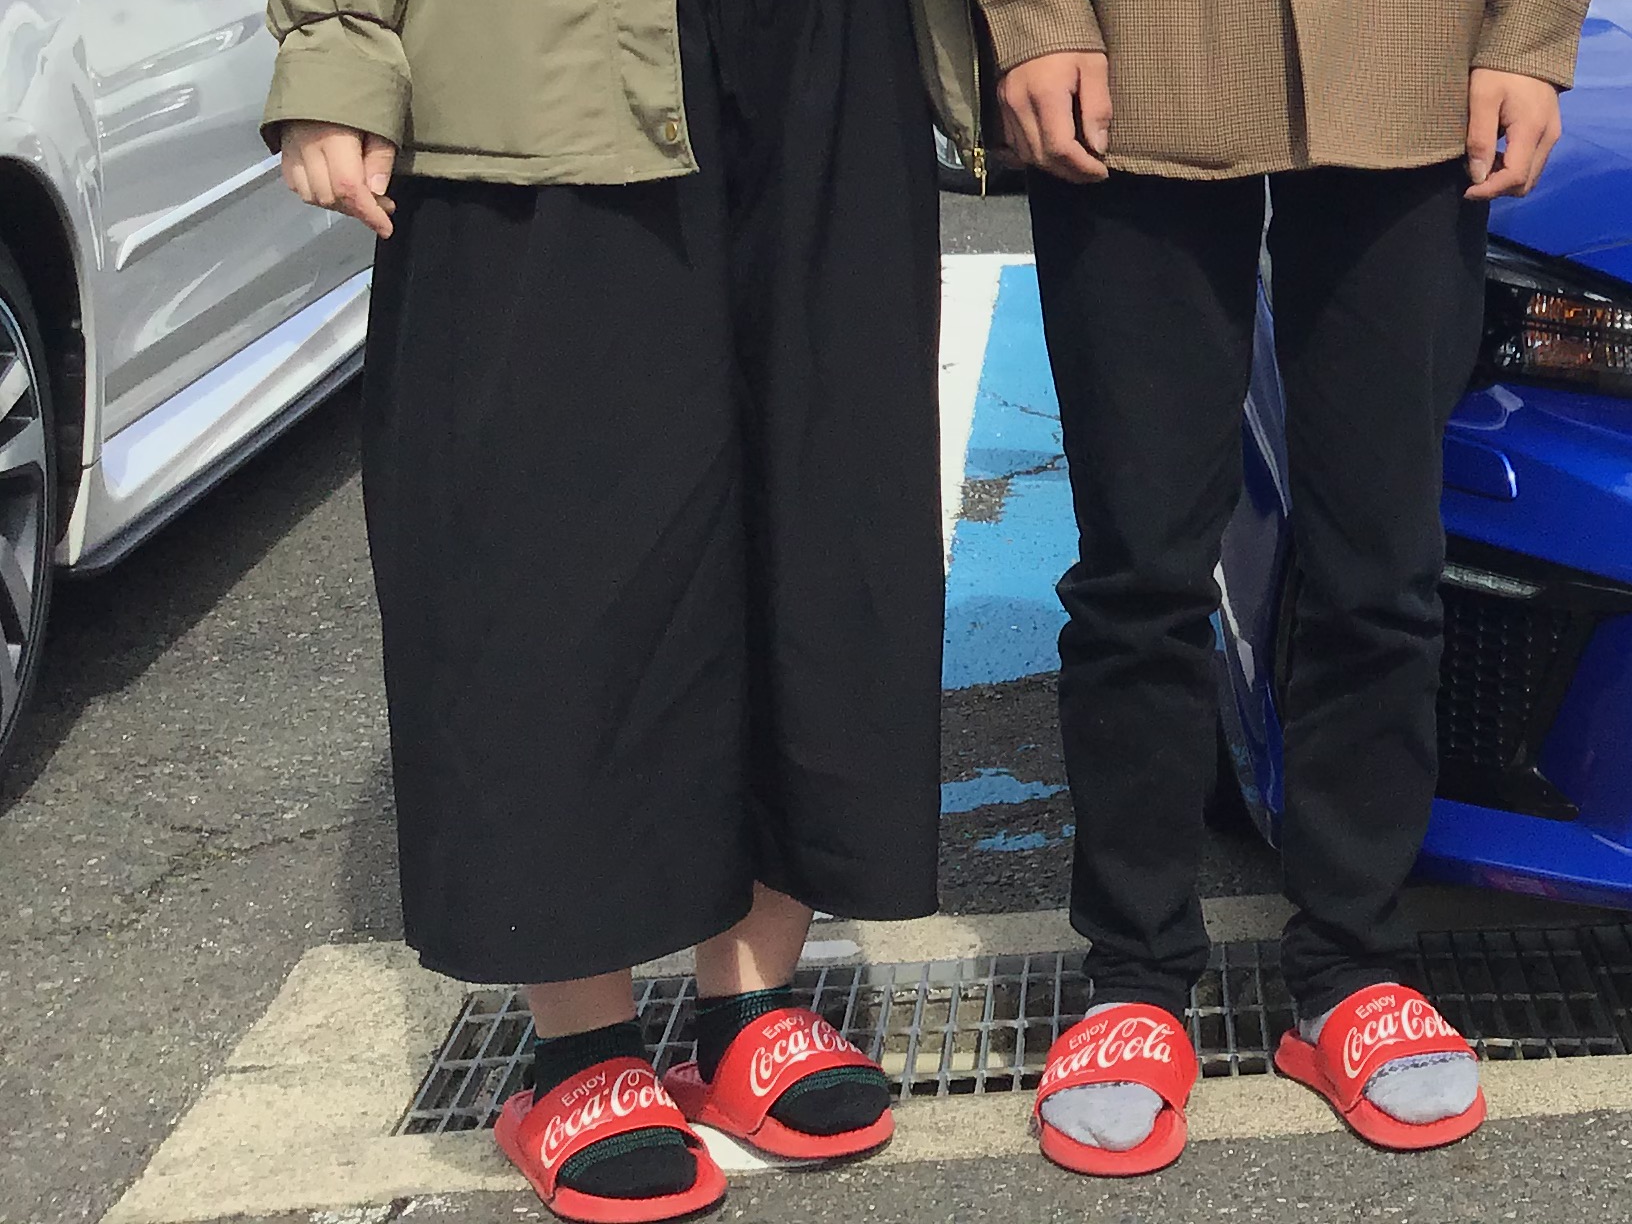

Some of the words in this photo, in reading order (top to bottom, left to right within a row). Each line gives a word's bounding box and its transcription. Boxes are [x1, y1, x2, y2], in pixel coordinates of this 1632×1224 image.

[1355, 994, 1396, 1019] Enjoy
[761, 1014, 805, 1040] Enjoy
[1068, 1019, 1109, 1050] Enjoy
[749, 1019, 863, 1097] Coca-Co
[561, 1070, 606, 1107] Enjoy
